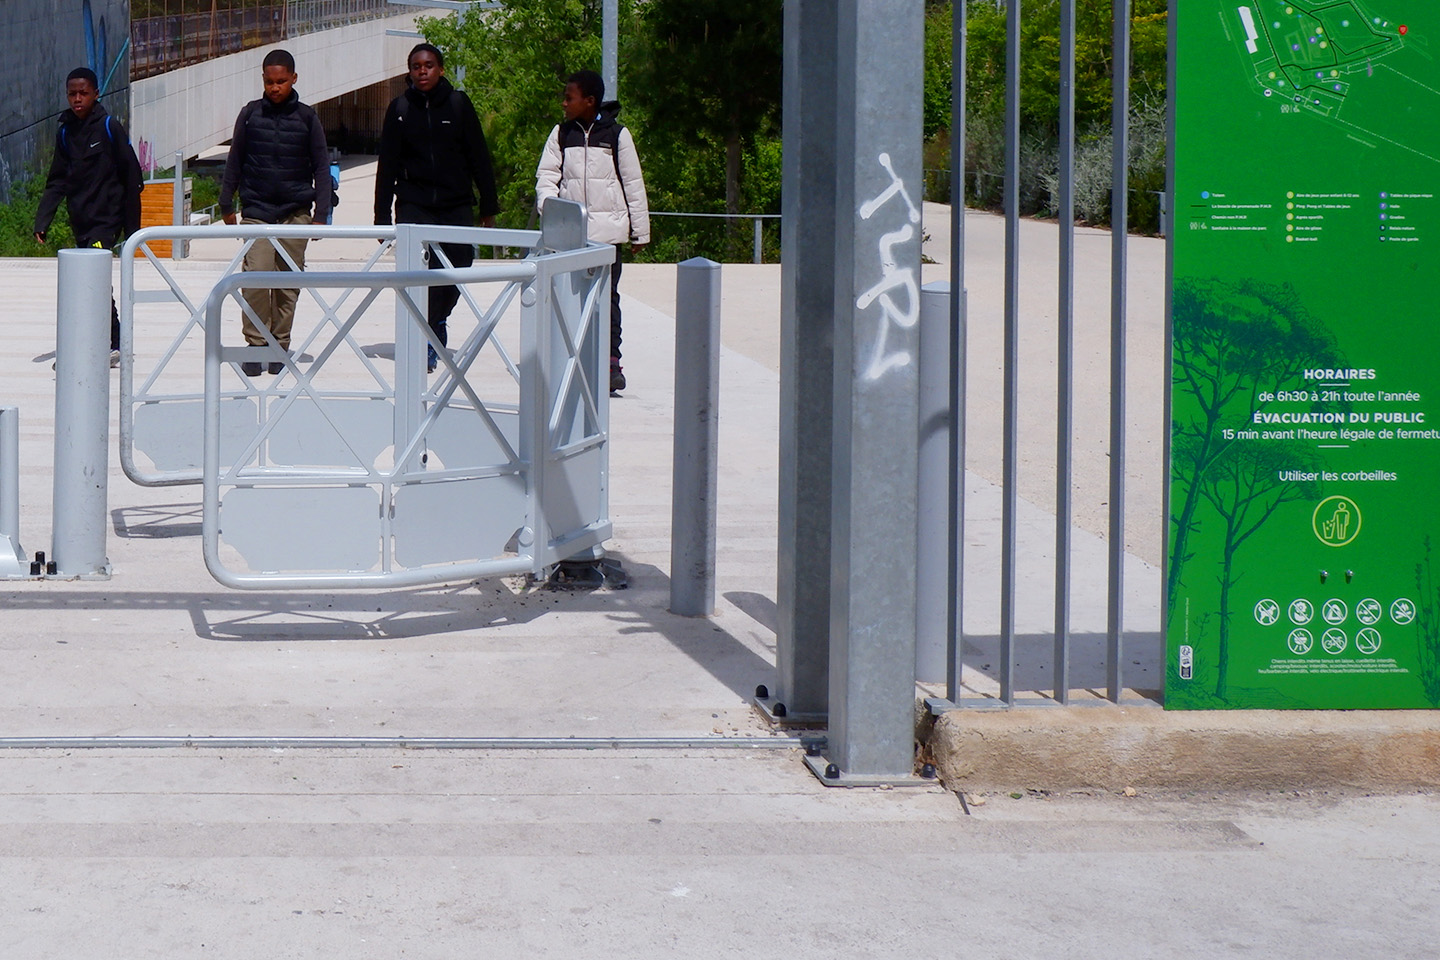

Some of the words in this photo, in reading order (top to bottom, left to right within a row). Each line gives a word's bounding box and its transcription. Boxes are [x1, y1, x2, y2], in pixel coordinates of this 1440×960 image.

[1304, 369, 1376, 380] HORAIRES
[1259, 391, 1274, 402] de
[1277, 391, 1308, 402] 6h30
[1310, 391, 1318, 402] à
[1322, 391, 1340, 402] 21h
[1343, 392, 1375, 402] toute
[1378, 391, 1420, 402] l'année
[1253, 410, 1345, 423] ÉVACUATION
[1349, 413, 1369, 423] DU
[1374, 413, 1425, 423] PUBLIC
[1222, 429, 1234, 440] 15
[1237, 429, 1259, 440] min
[1261, 430, 1294, 440] avant
[1297, 429, 1338, 440] l'heure
[1340, 429, 1375, 442] légale
[1378, 429, 1394, 440] de
[1278, 470, 1319, 481] Utiliser
[1322, 470, 1338, 481] les
[1341, 470, 1397, 481] corbeilles
